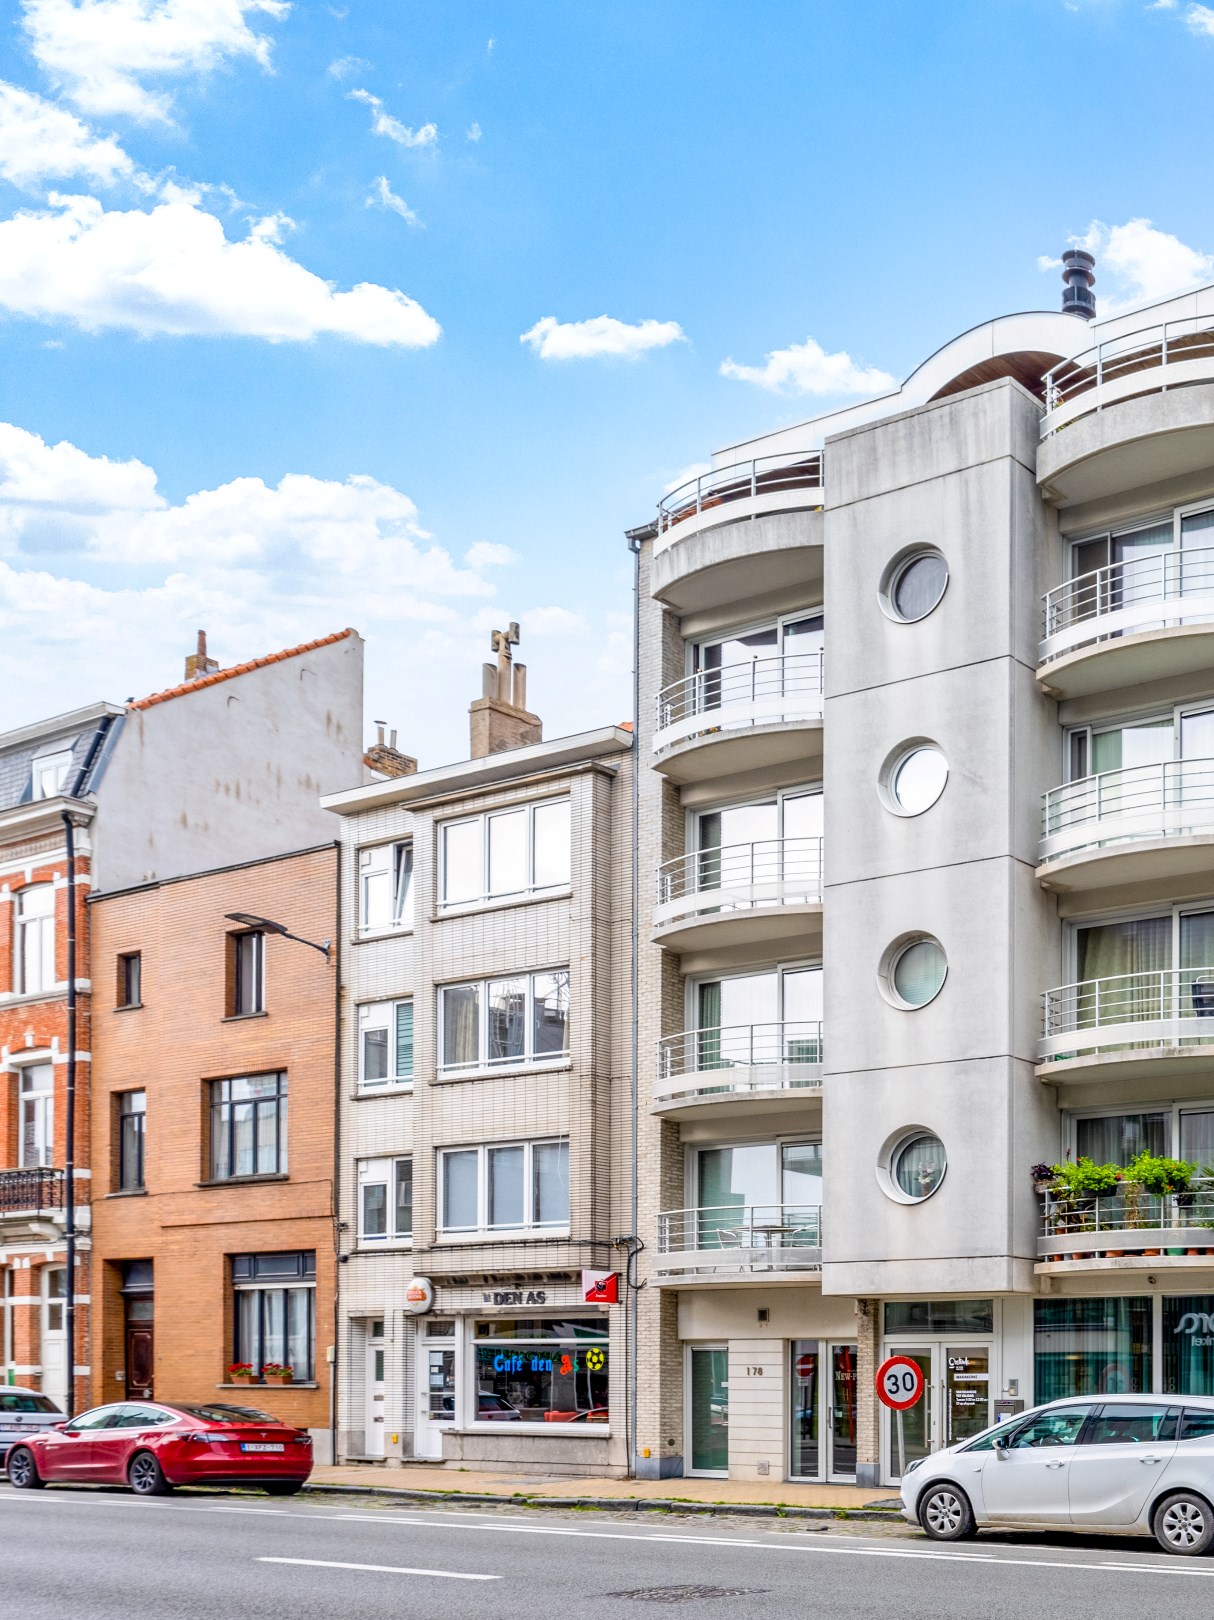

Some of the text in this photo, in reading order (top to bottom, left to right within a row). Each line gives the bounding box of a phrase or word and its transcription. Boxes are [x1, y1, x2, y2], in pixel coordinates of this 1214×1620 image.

[493, 1291, 523, 1305] DEN
[526, 1291, 546, 1304] AS
[493, 1354, 523, 1375] Café
[530, 1354, 553, 1372] den
[746, 1366, 763, 1376] 178
[887, 1372, 914, 1394] 30
